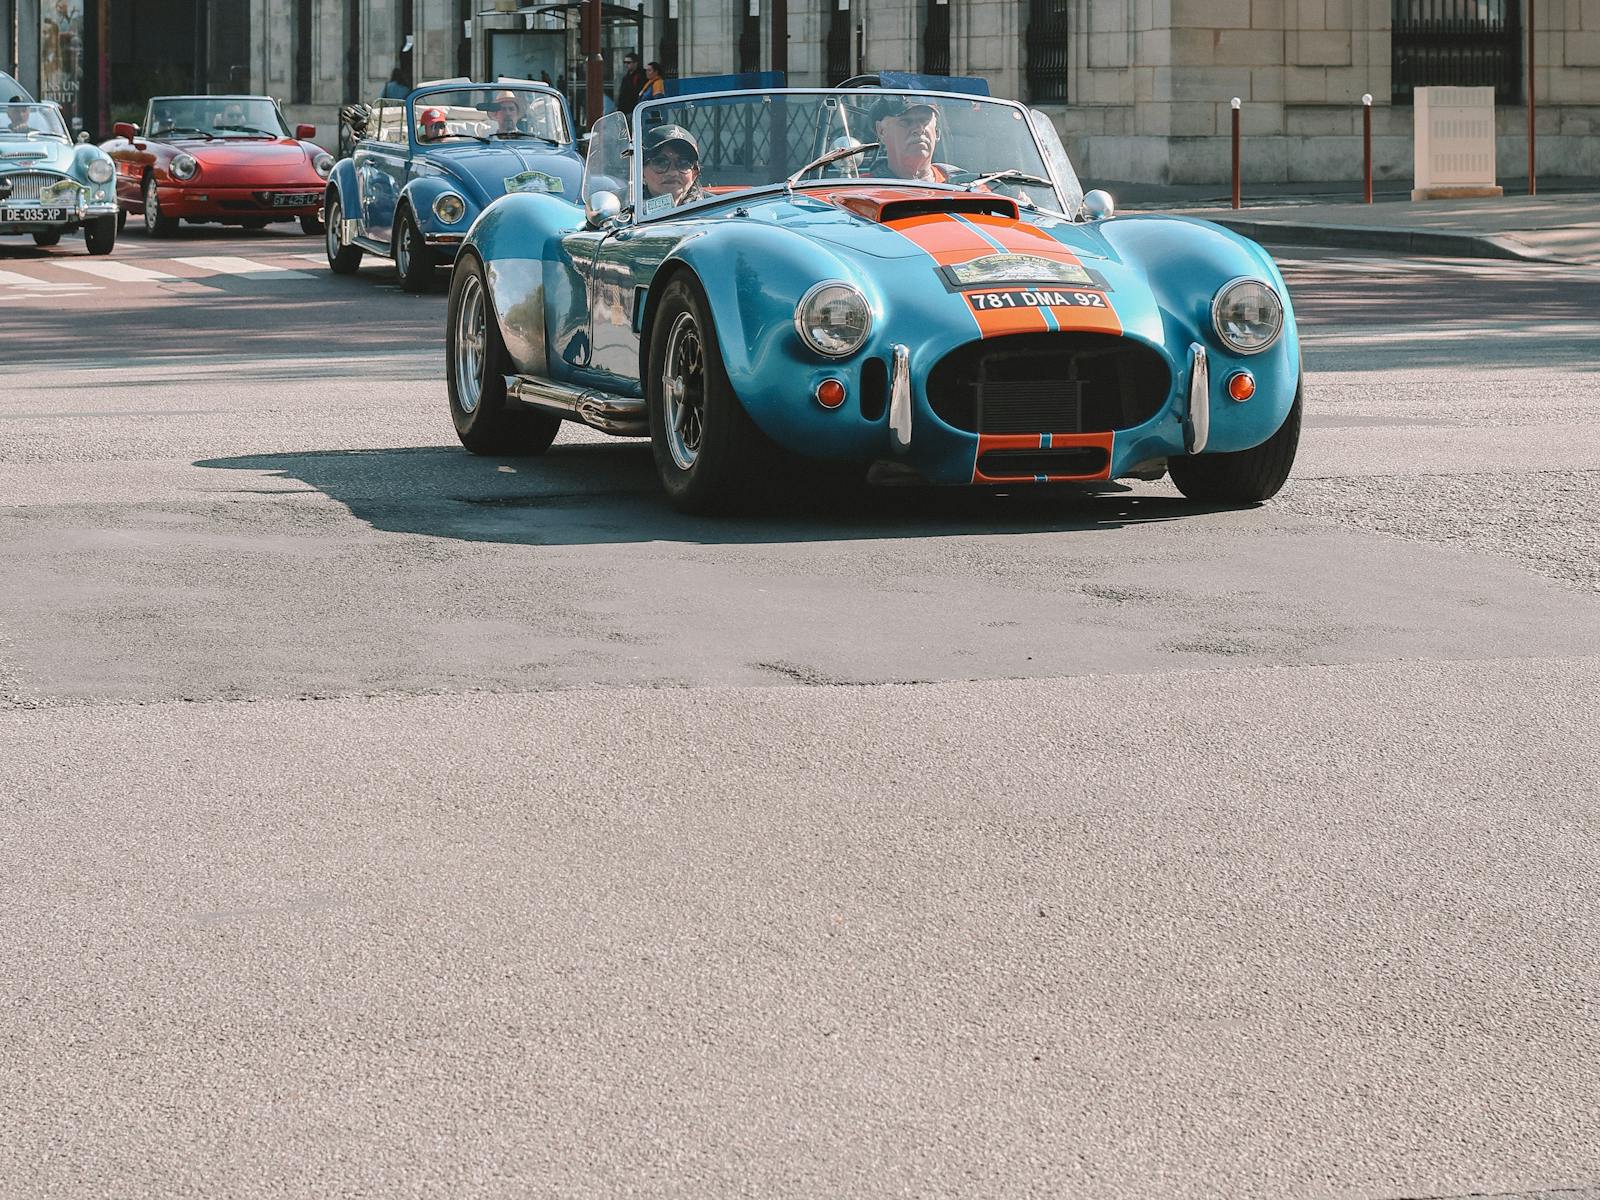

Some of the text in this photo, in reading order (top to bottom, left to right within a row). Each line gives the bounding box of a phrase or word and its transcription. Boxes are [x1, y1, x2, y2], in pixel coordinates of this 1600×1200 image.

[62, 80, 80, 91] UN
[6, 208, 61, 221] DE-035-XP
[972, 291, 1105, 309] 781 DMA 92
